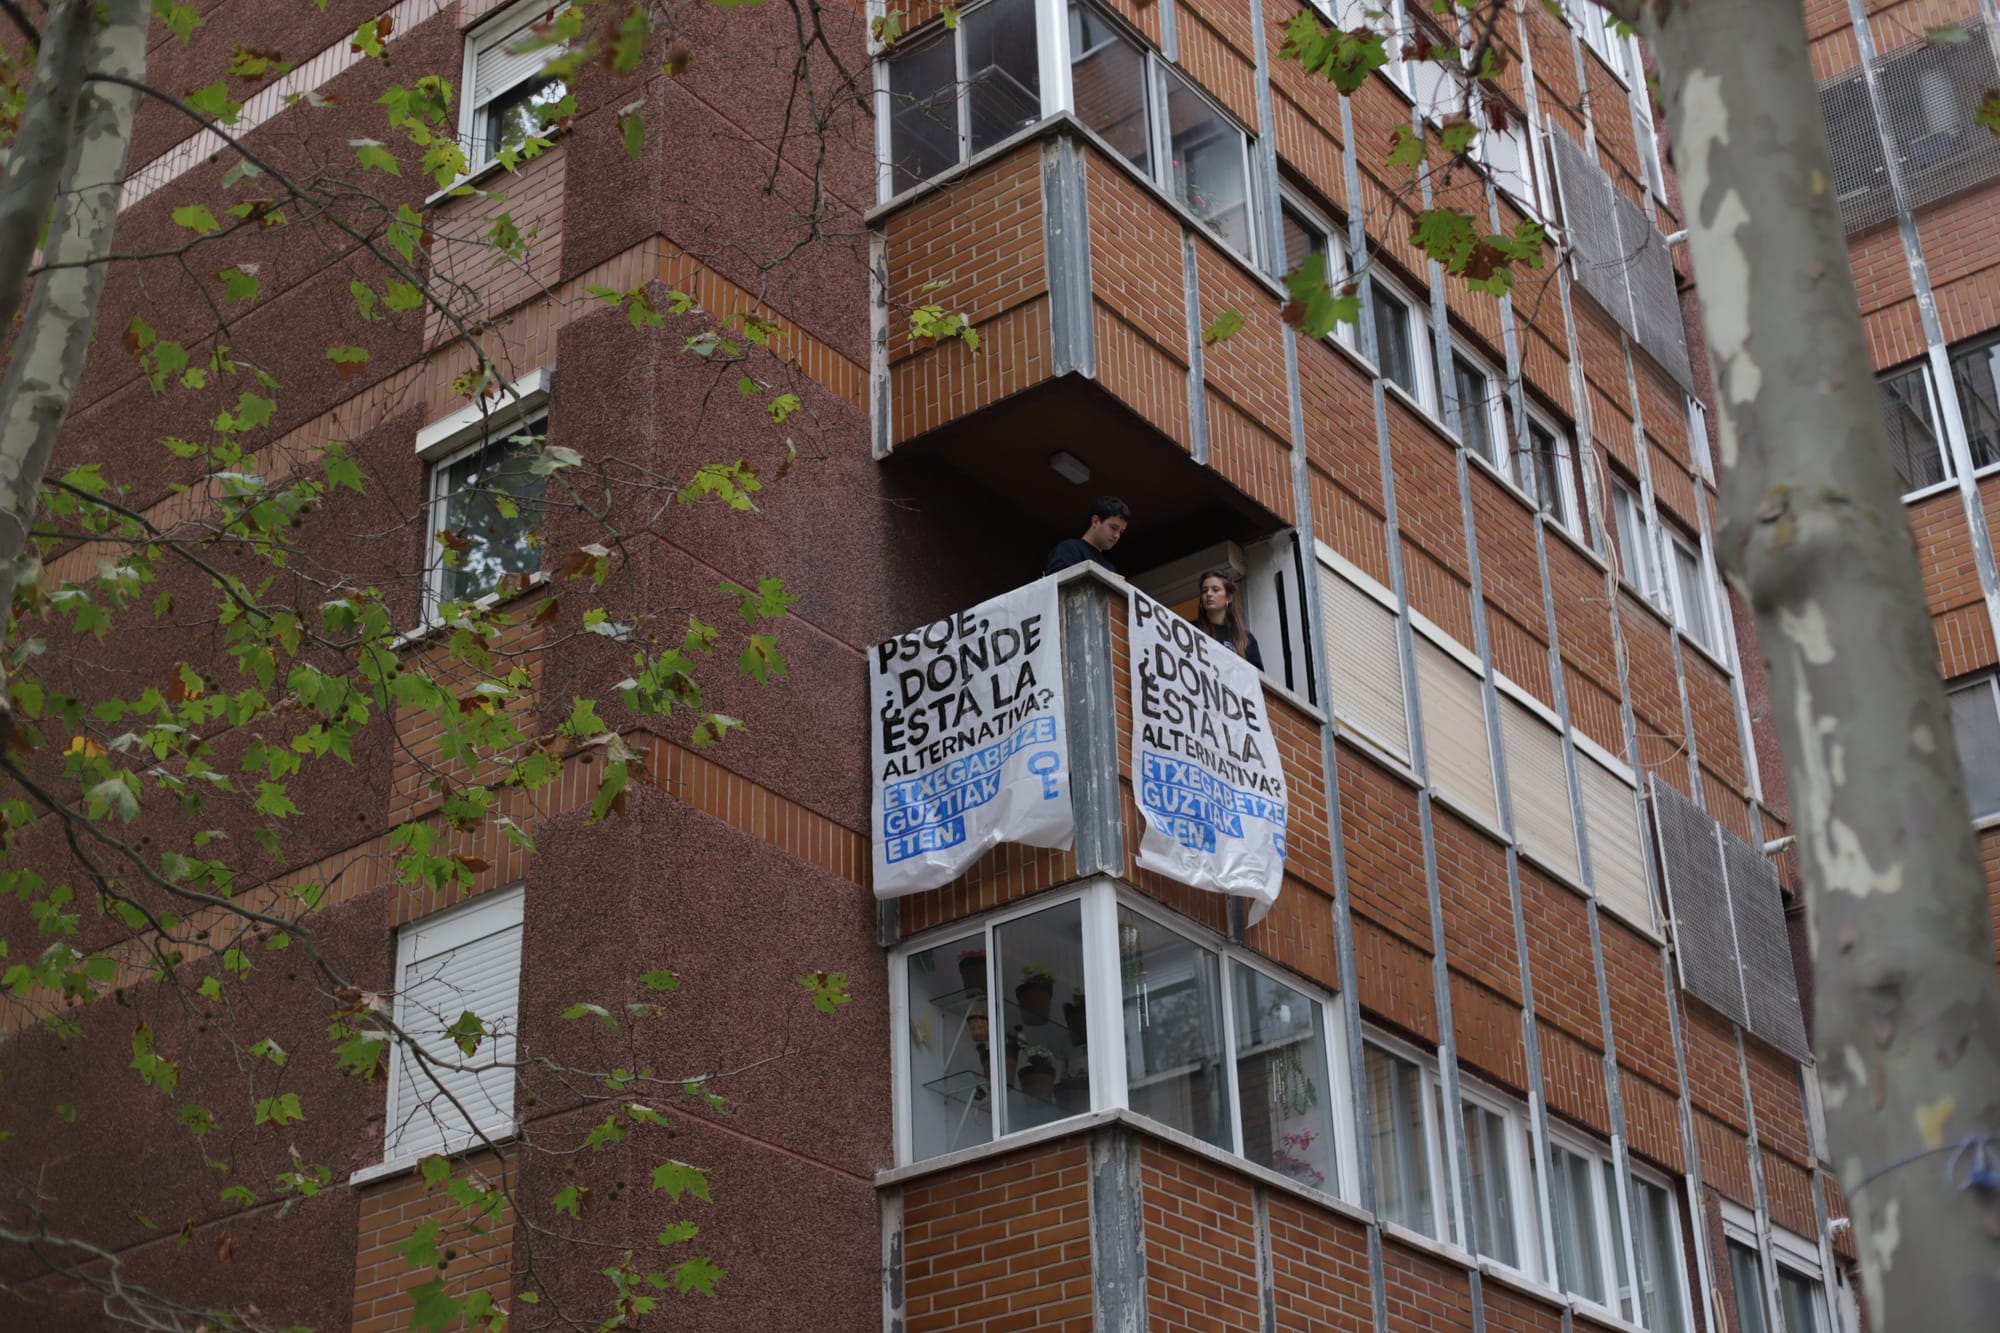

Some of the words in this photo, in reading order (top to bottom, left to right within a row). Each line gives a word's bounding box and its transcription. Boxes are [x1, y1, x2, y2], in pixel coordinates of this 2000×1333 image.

[878, 611, 989, 675] PSOE,
[990, 660, 1037, 709] LA
[882, 688, 1054, 781] ALTERNATIVA?
[885, 719, 1053, 808] ETXEGABETZE
[1142, 723, 1282, 797] ALTERNATIVA?
[1222, 723, 1266, 769] LA
[886, 777, 998, 835] GUZTIAK
[1144, 782, 1241, 837] GUZTIAK
